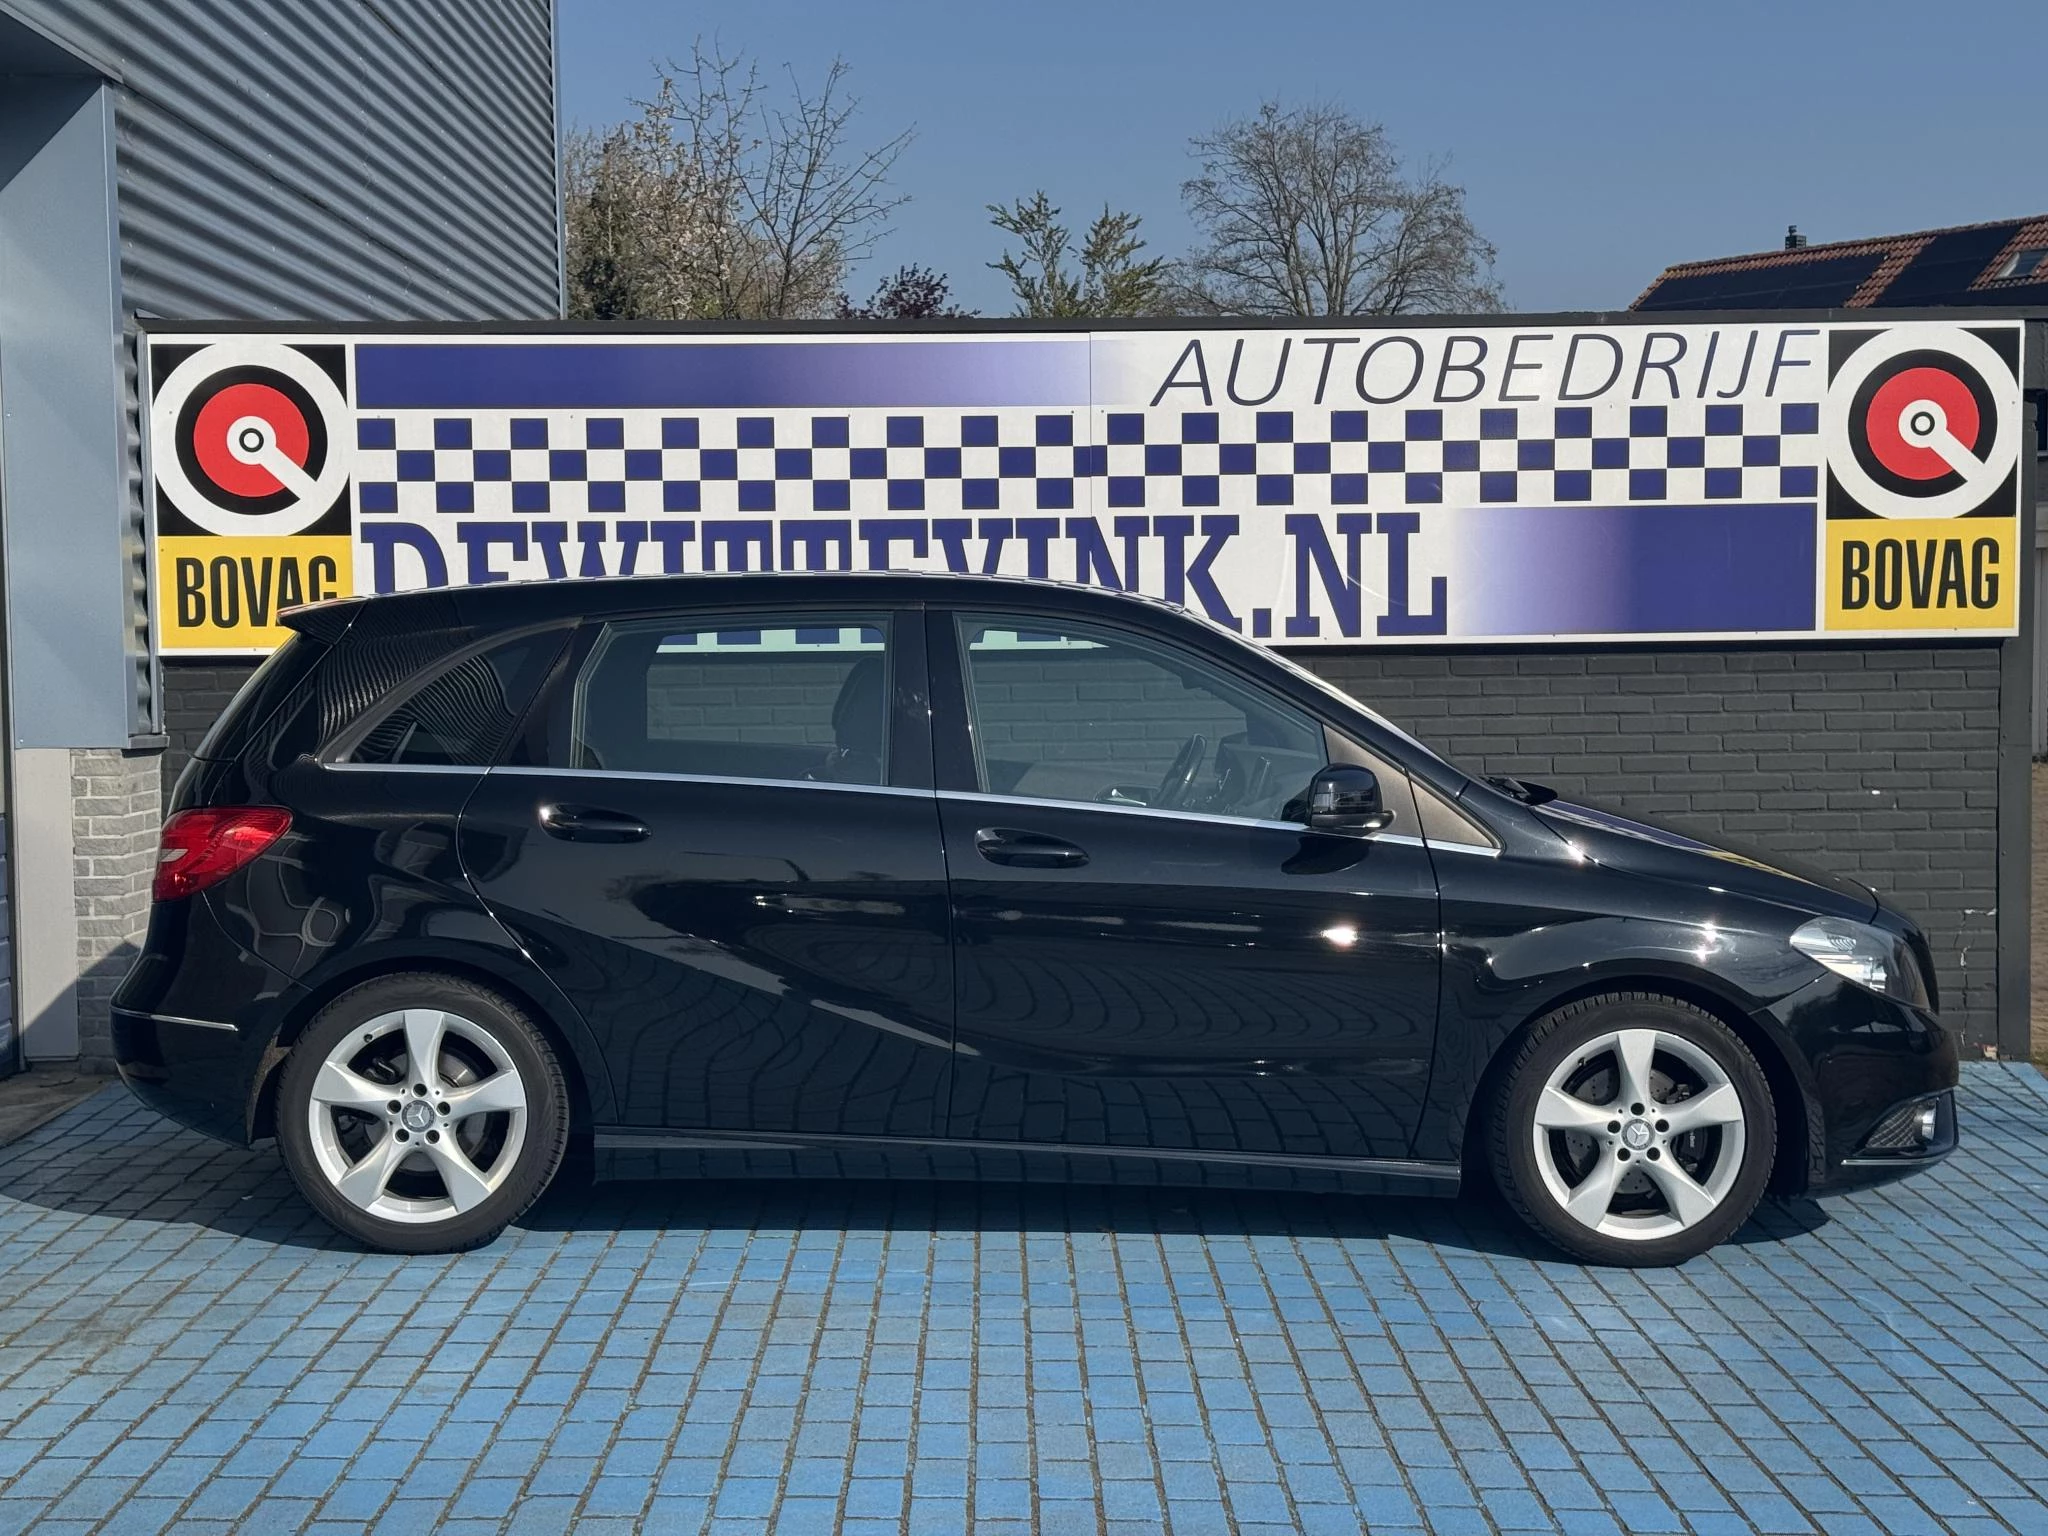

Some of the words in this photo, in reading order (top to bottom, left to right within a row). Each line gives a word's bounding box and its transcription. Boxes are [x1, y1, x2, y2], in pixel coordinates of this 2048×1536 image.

[1150, 329, 1820, 407] AUTOBEDRIJF
[175, 555, 337, 629] BOVAG
[1841, 537, 2000, 611] BOVAG
